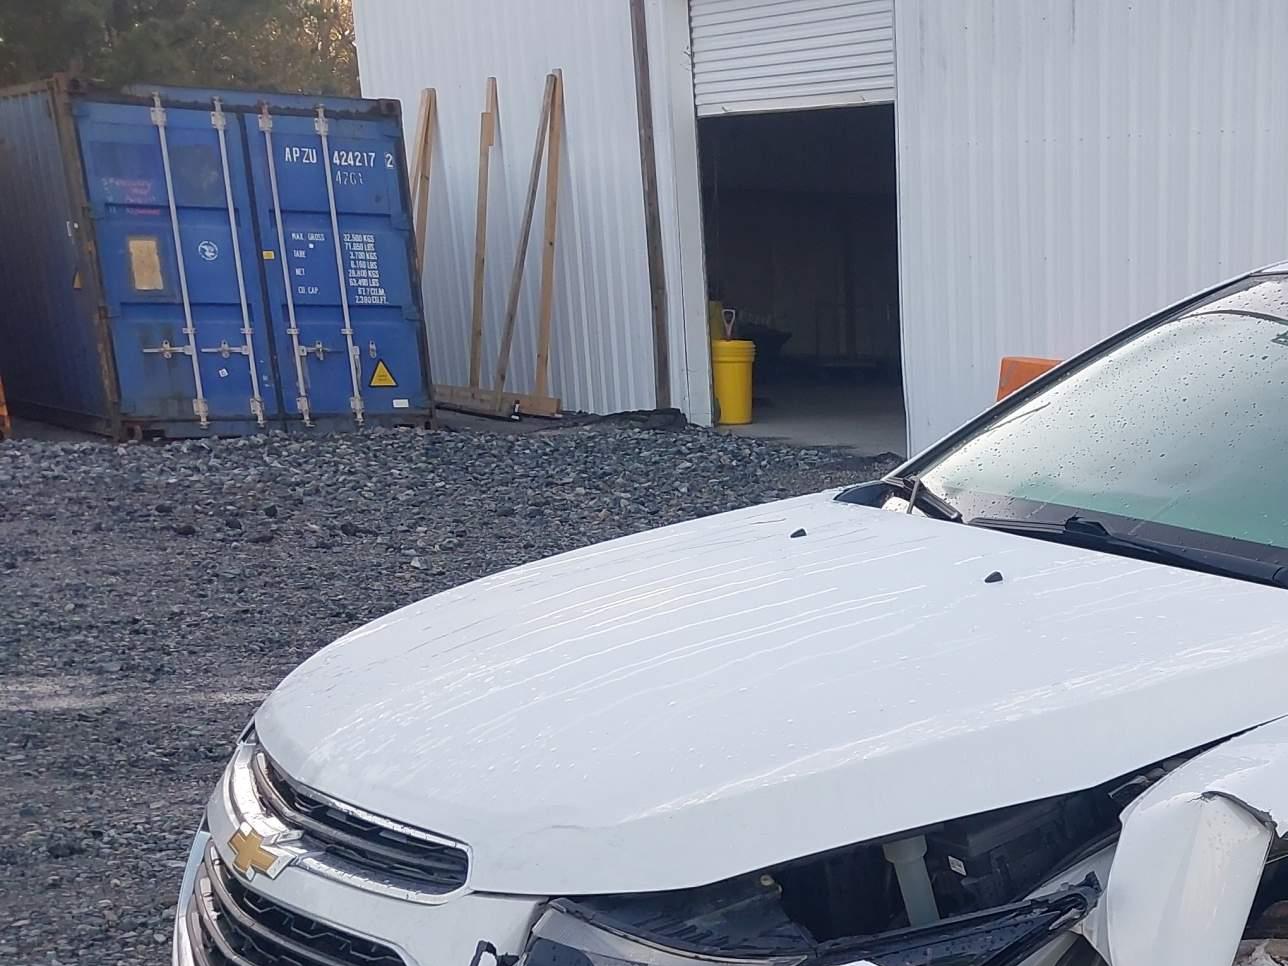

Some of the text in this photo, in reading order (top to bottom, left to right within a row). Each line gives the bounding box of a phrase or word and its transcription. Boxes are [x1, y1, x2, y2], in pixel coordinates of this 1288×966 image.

[285, 147, 394, 168] APZU 424217 2
[363, 234, 375, 242] KGS
[364, 243, 375, 251] LBS
[366, 252, 377, 260] KGS
[367, 261, 378, 269] LBS
[295, 268, 305, 276] NET
[368, 270, 379, 278] KGS
[369, 279, 379, 287] LBS
